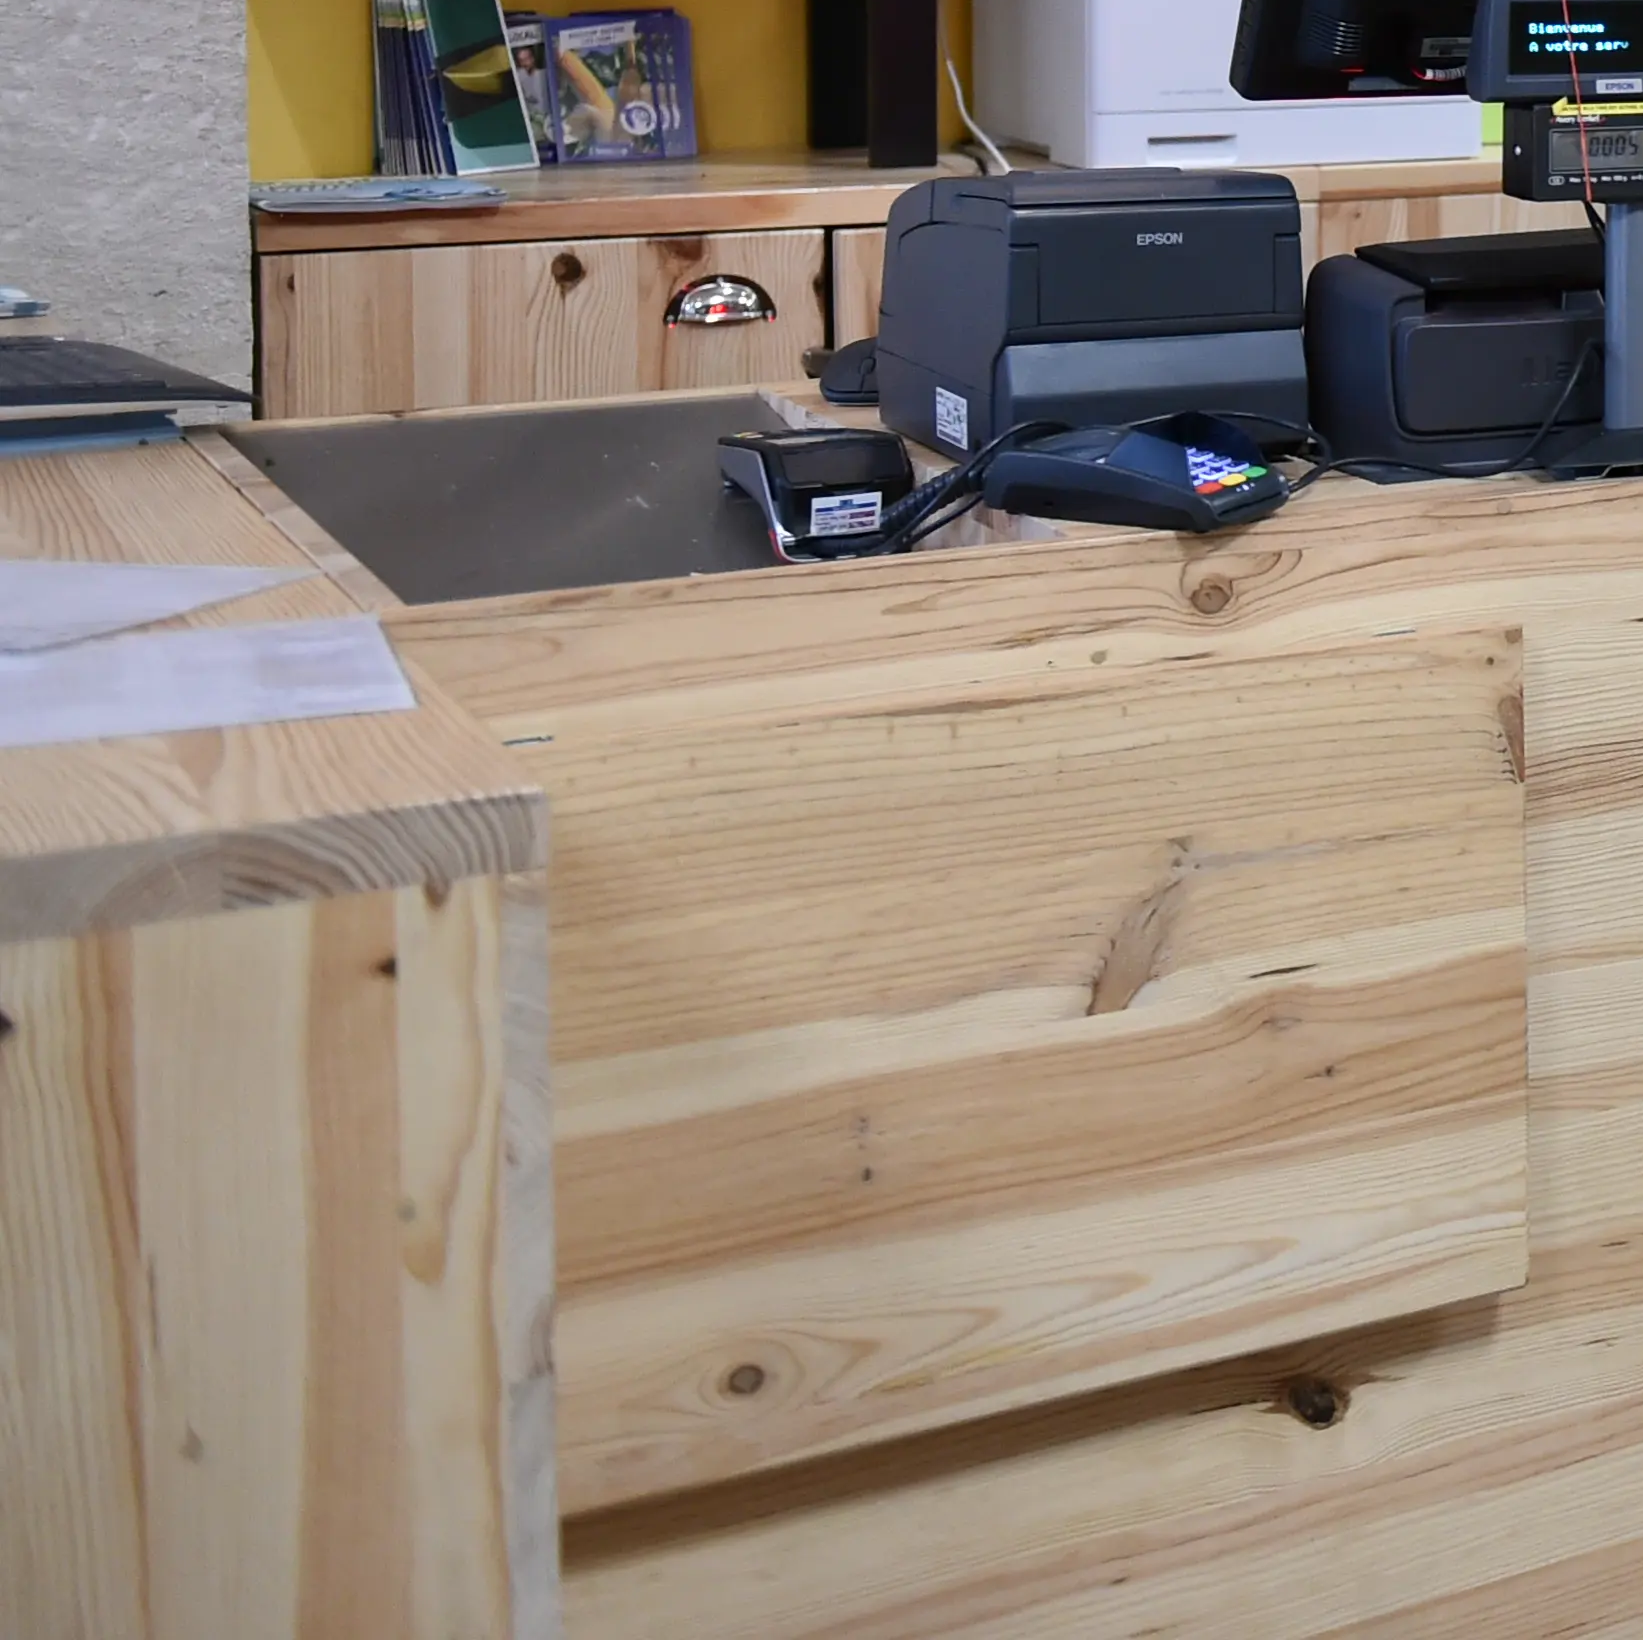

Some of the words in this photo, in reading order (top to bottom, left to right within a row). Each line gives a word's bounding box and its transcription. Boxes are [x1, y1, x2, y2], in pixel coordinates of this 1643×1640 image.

[1528, 22, 1605, 35] Bienvenue
[1528, 41, 1539, 52] A
[1545, 40, 1589, 53] votre
[1605, 82, 1635, 91] EPSON
[1136, 232, 1183, 246] EPSON
